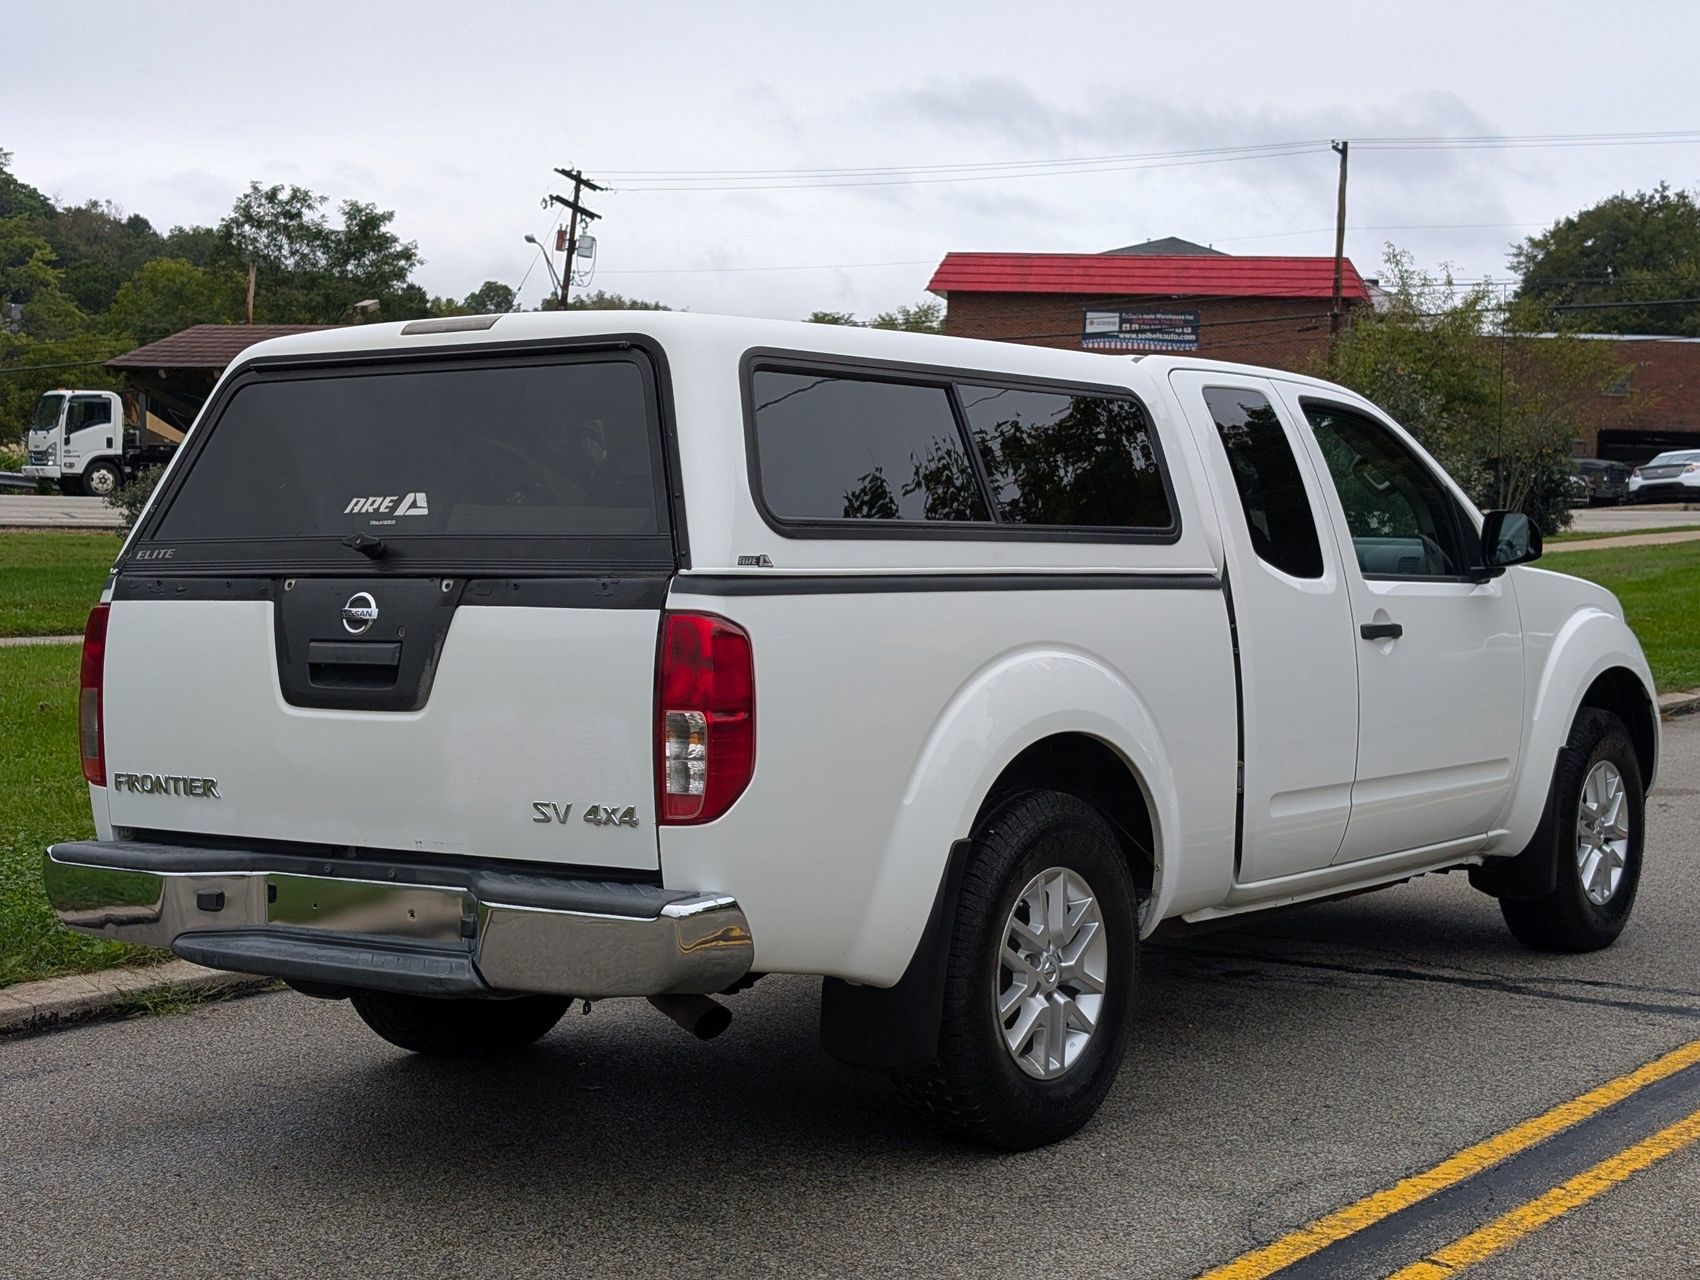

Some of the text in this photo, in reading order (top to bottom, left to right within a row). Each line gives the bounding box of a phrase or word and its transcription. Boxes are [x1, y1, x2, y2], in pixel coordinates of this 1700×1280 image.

[343, 496, 399, 514] ARE
[136, 548, 177, 560] ELITE
[114, 772, 220, 799] FRONTIER
[532, 801, 573, 825] SV
